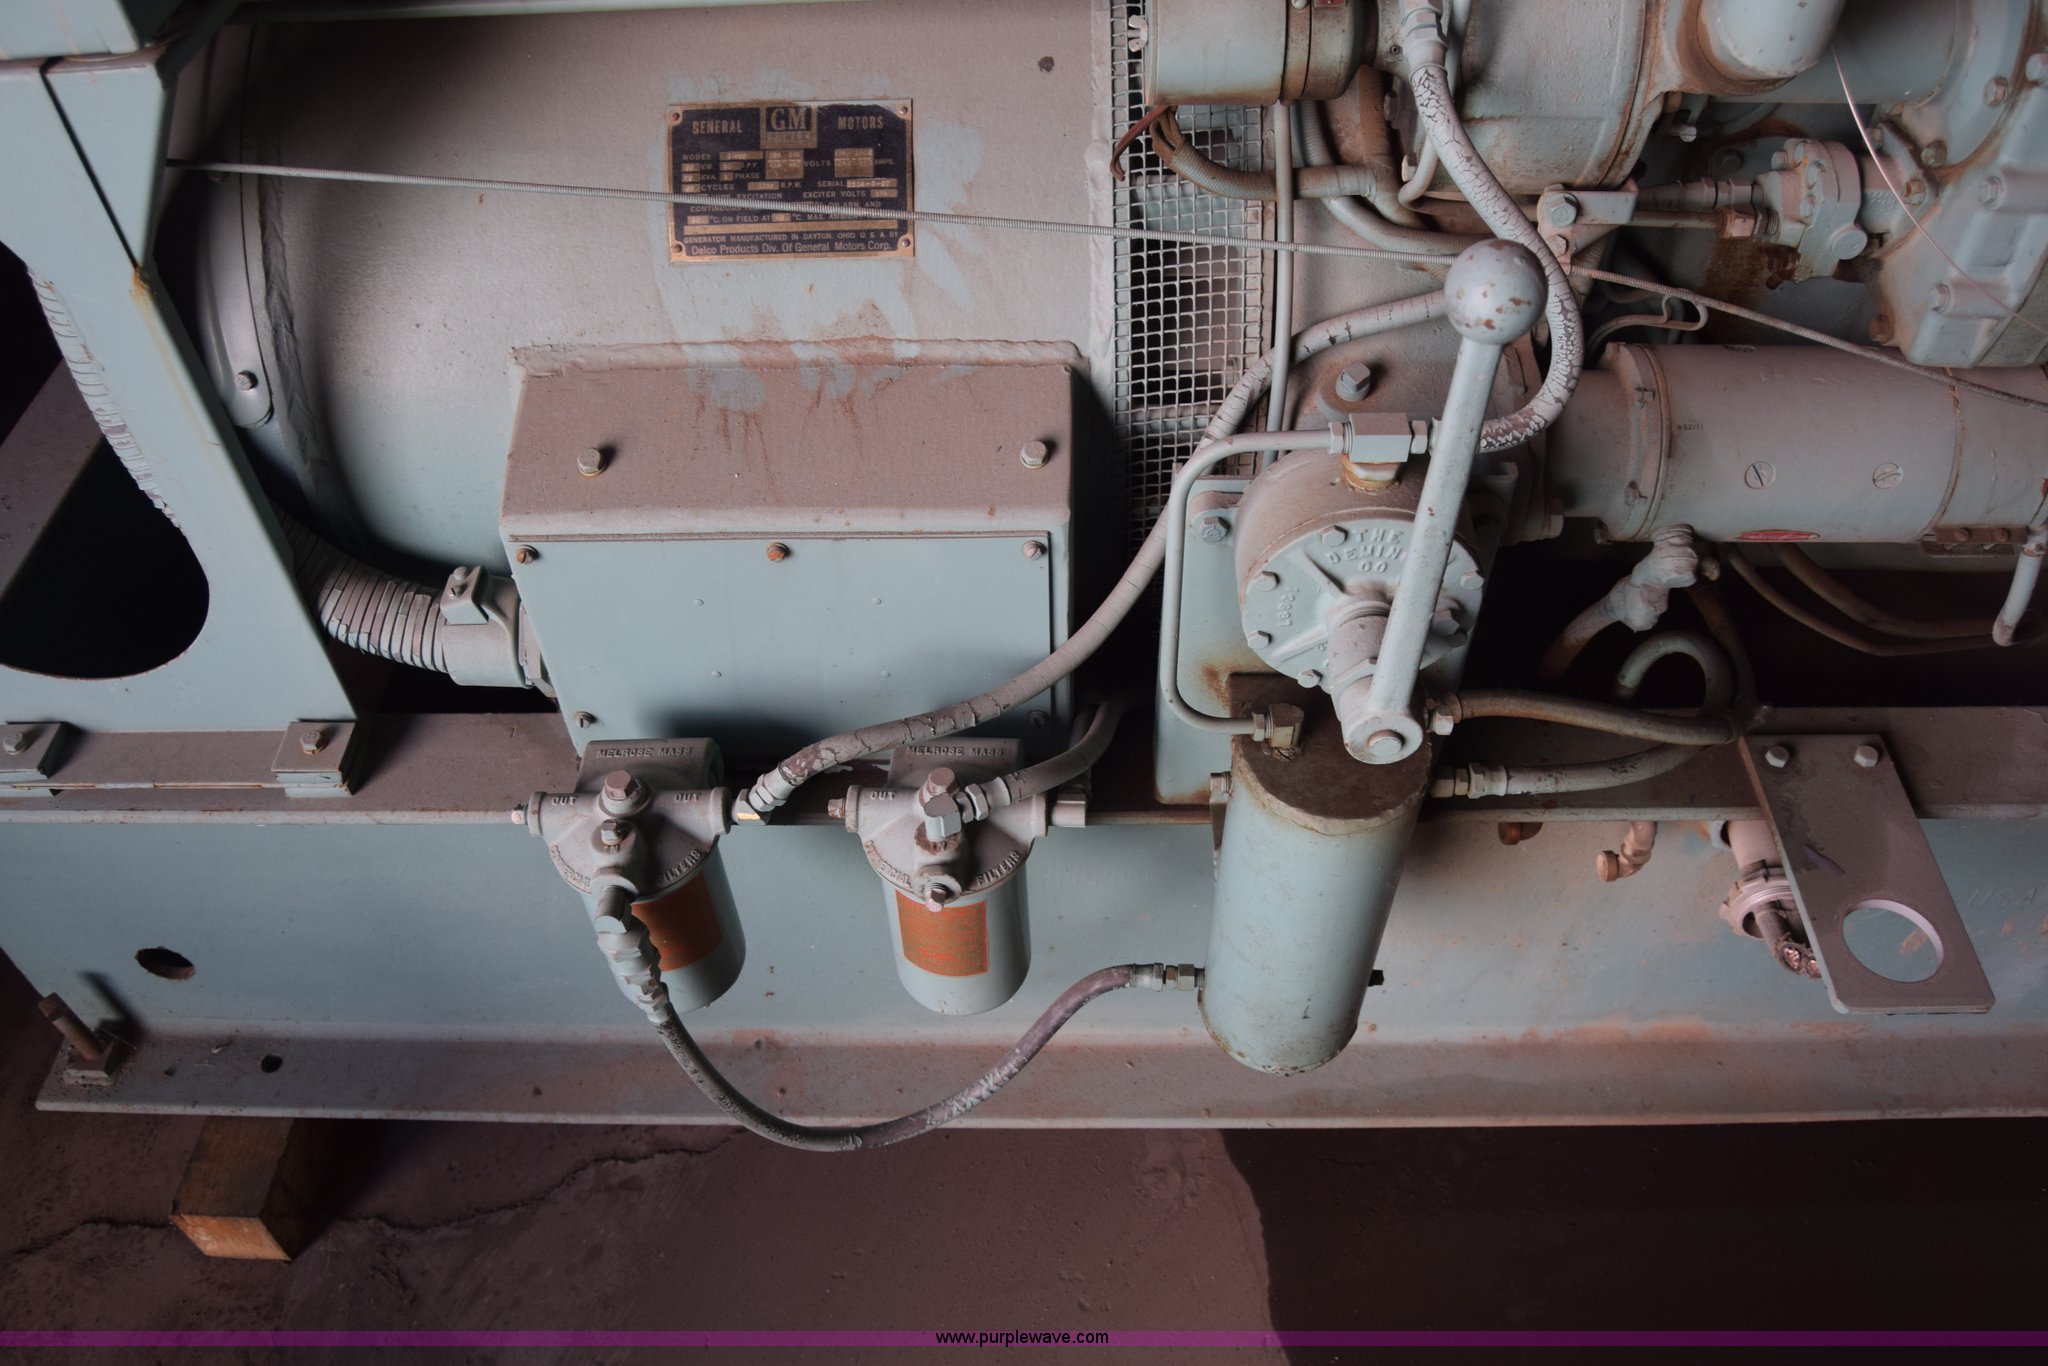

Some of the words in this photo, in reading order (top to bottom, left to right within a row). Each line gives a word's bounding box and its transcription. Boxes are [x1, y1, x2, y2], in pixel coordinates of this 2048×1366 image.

[771, 108, 807, 131] GM
[838, 116, 884, 130] MOTORS
[692, 120, 743, 134] GENERAL
[734, 172, 760, 180] PHASE
[701, 184, 735, 192] CYCLES
[816, 180, 844, 188] SERIAL
[803, 191, 836, 199] EXCITER
[841, 190, 866, 198] VOLTS
[684, 236, 726, 244] GENERATOR
[730, 234, 788, 243] MANUFACTURED
[691, 246, 717, 255] Delco
[719, 244, 759, 254] Products
[762, 243, 779, 253] Div.
[781, 242, 793, 252] Of
[794, 242, 830, 252] General
[834, 241, 866, 251] Motors
[867, 240, 892, 251] Corp.
[1352, 528, 1405, 544] THE
[1327, 544, 1408, 565] DEMIN
[1360, 560, 1388, 573] CO
[596, 747, 654, 758] MELROSE
[657, 746, 693, 757] MASS
[906, 745, 965, 757] MELROSE
[969, 748, 1004, 757] MASS
[552, 795, 578, 806] OUT
[674, 792, 702, 803] OUT
[870, 791, 897, 802] OUT
[656, 848, 702, 886] FILTERS
[976, 850, 1021, 887] FILTERS
